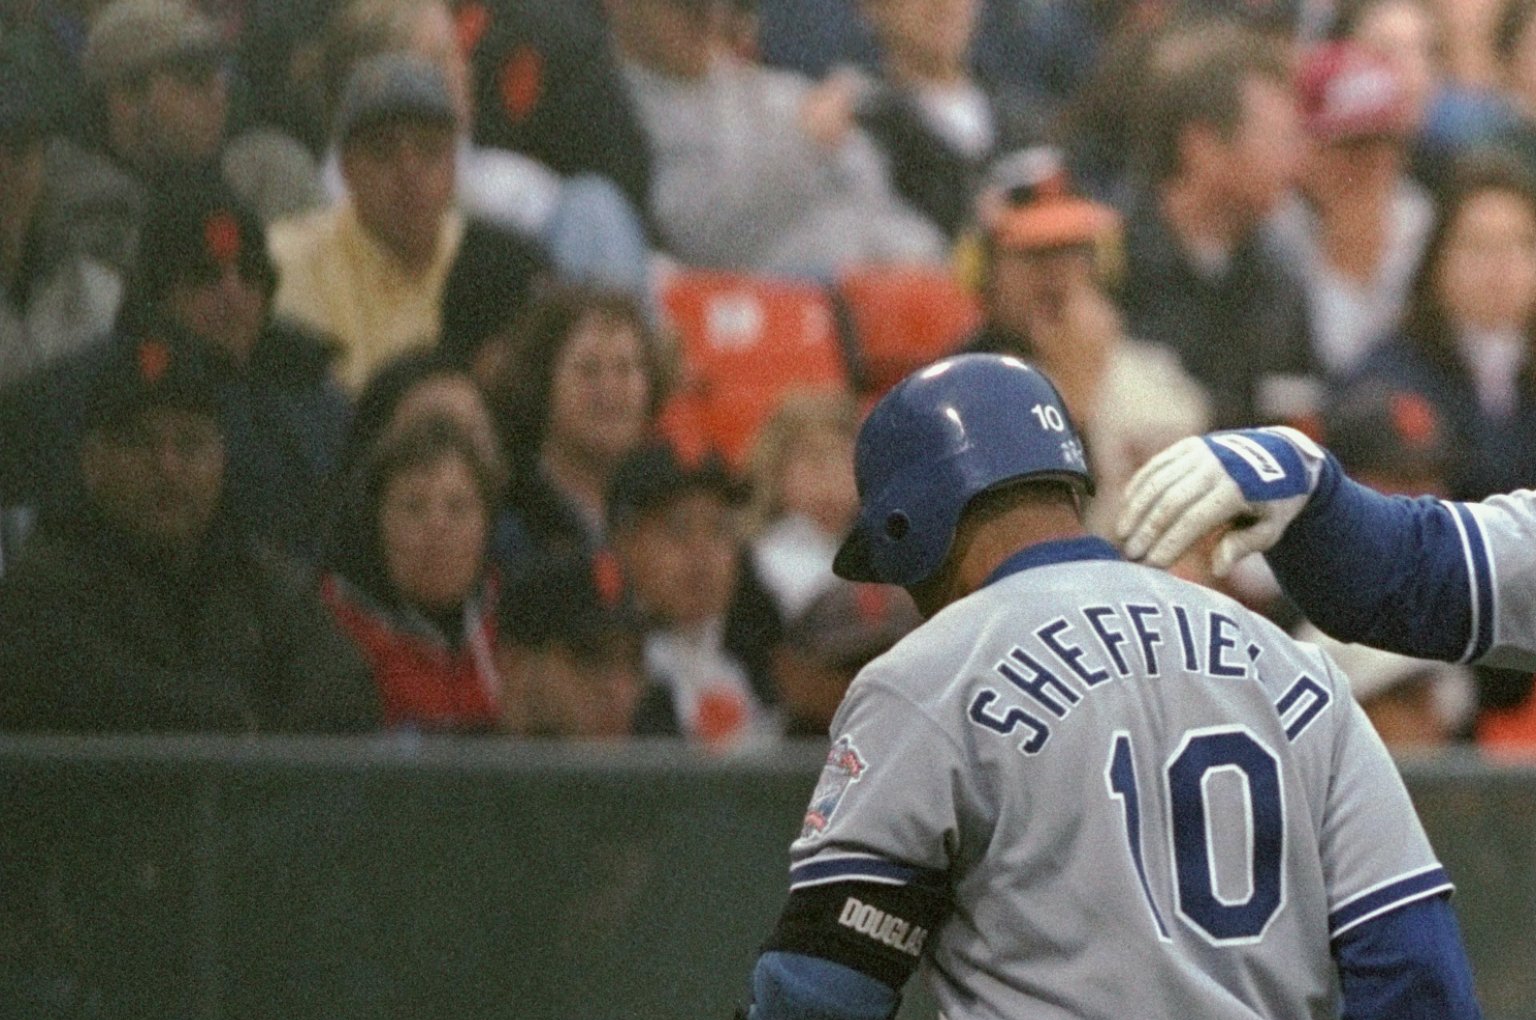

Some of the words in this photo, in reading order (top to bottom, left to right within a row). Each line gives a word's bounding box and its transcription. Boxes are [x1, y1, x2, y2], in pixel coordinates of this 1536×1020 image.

[1030, 403, 1065, 432] 10
[969, 602, 1334, 757] SHEFFIED
[1104, 724, 1288, 947] 10
